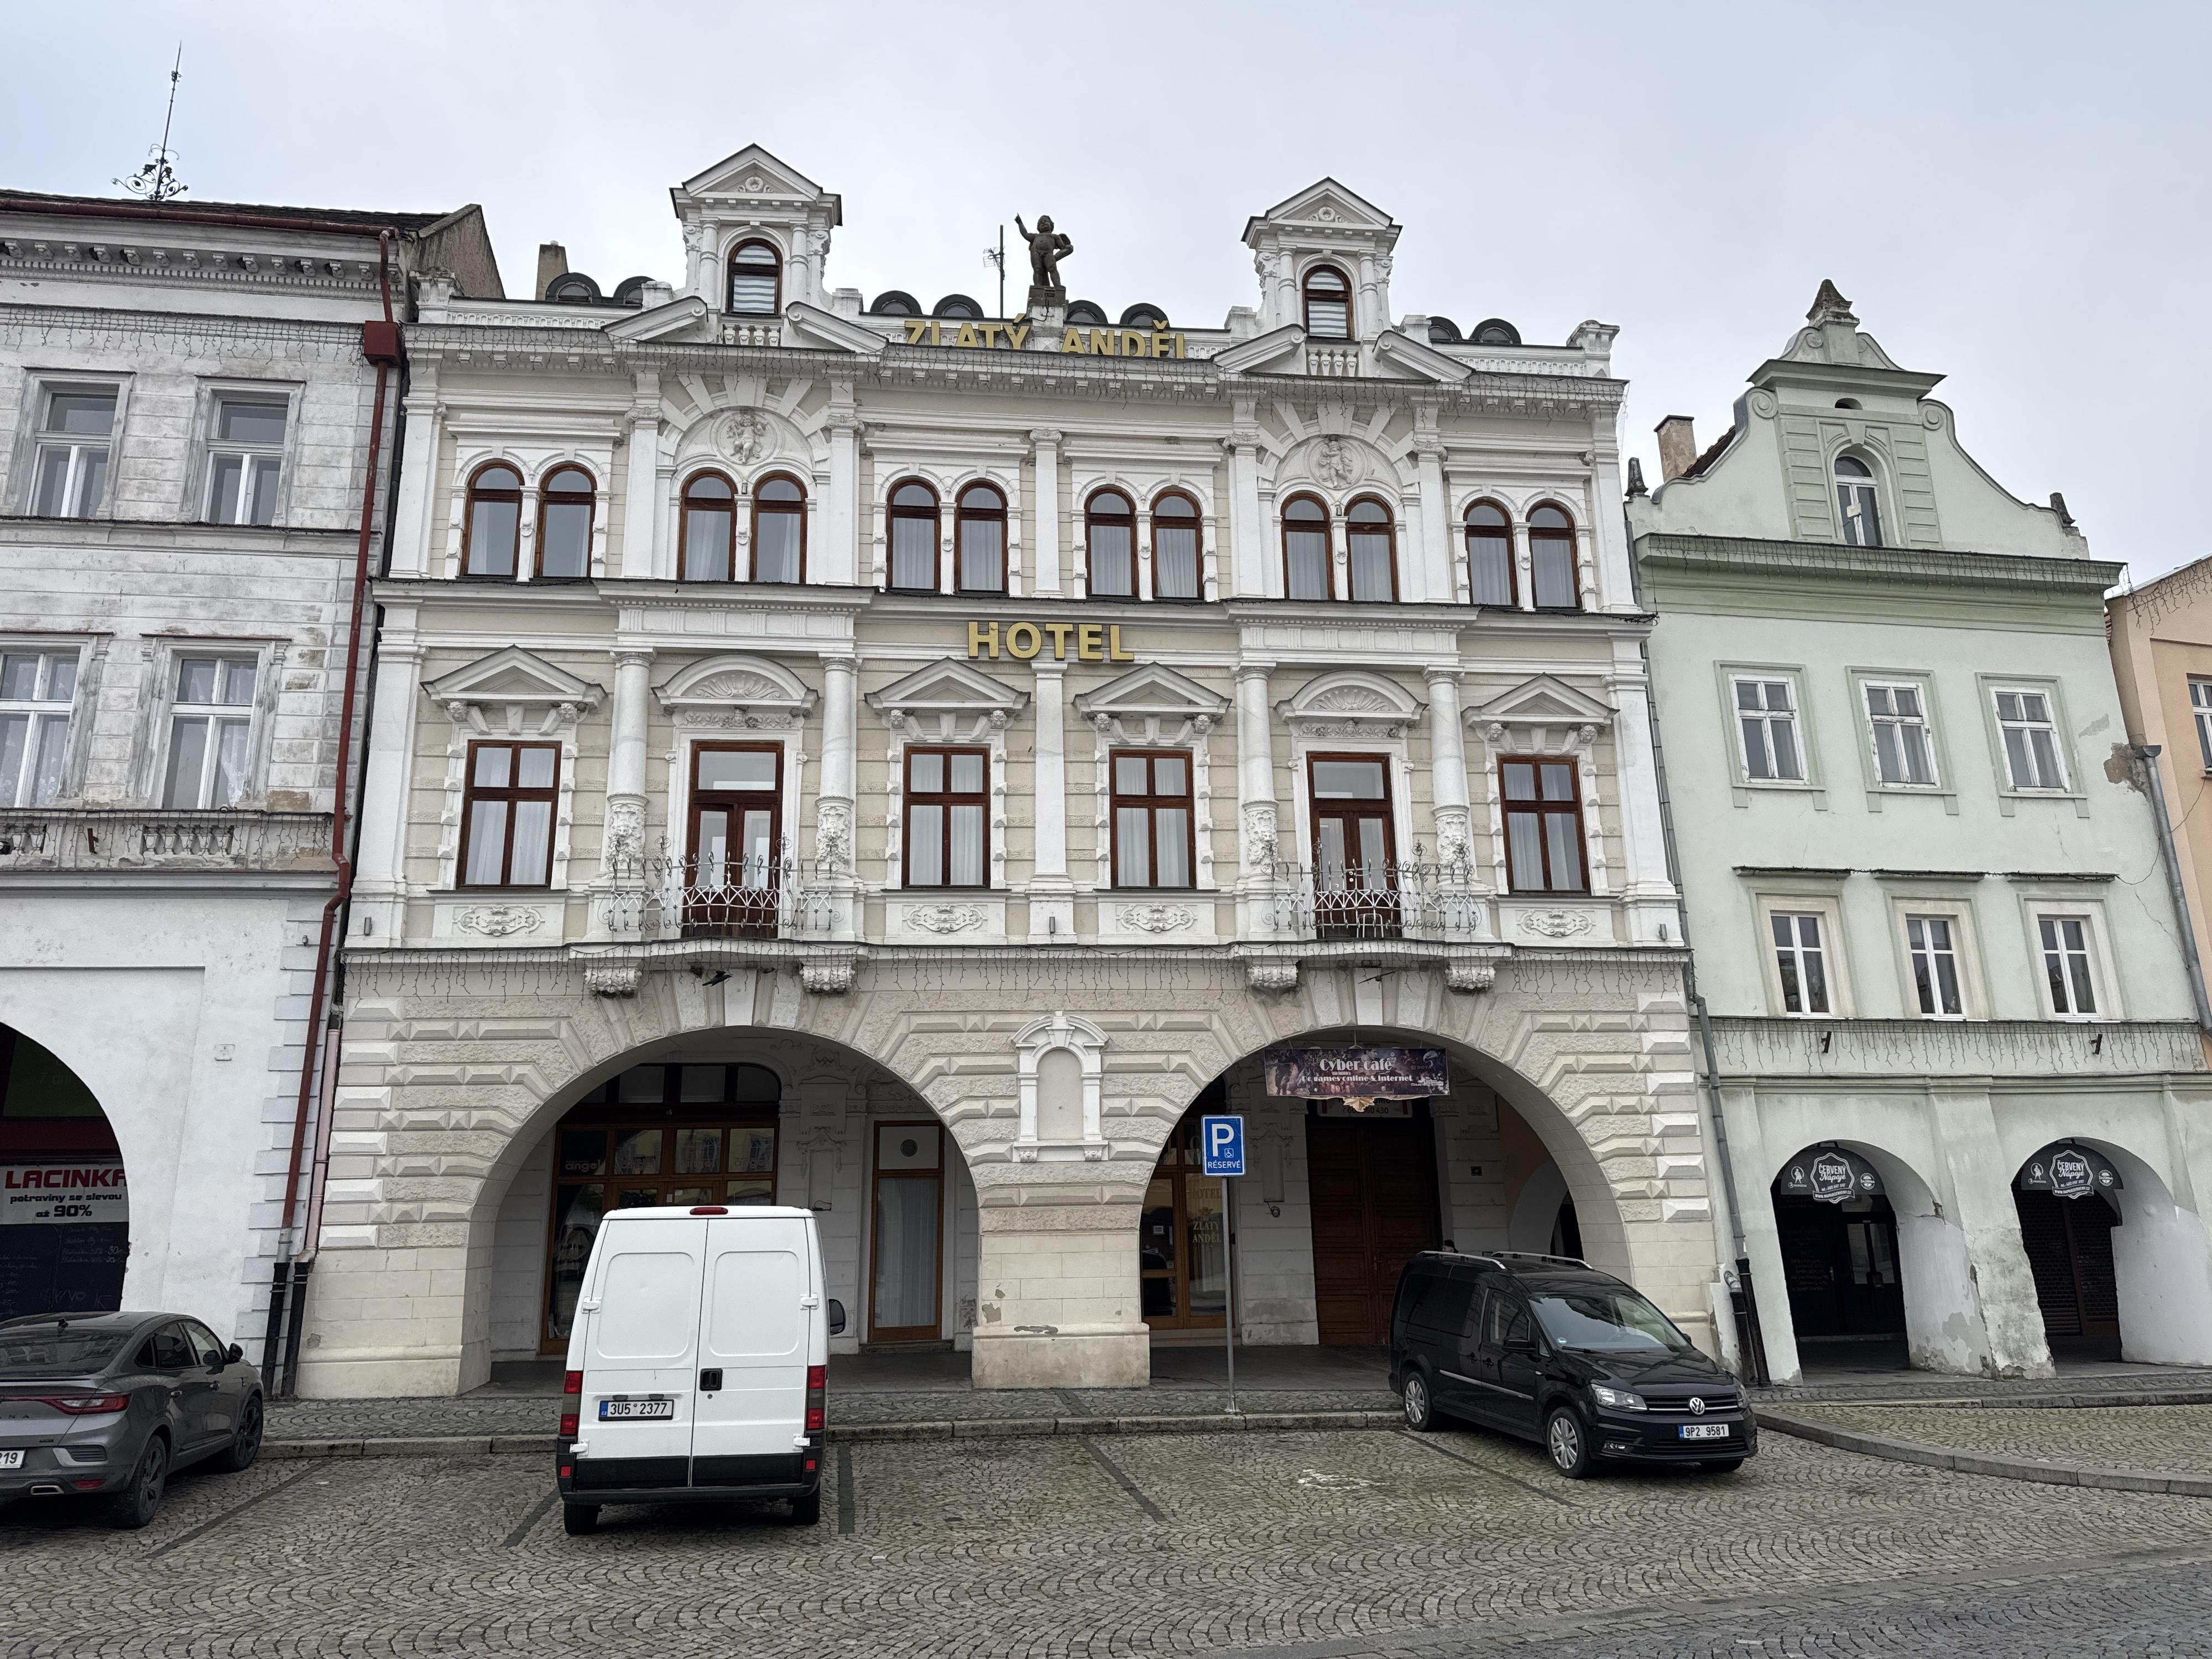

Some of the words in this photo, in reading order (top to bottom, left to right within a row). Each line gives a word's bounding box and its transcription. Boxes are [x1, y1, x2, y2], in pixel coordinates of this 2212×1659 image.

[968, 622, 1134, 662] HOTEL
[1320, 1058, 1360, 1071] Cyber
[1364, 1058, 1392, 1071] café
[1212, 1124, 1234, 1157] P
[1208, 1160, 1241, 1168] RÉSERVÉ
[1818, 1164, 1846, 1175] ČERVENÝ
[2057, 1160, 2084, 1171] ČERVENÝ
[5, 1169, 127, 1188] LACINKA
[1819, 1172, 1846, 1183] Nápoje
[2059, 1170, 2085, 1180] Nápoje
[10, 1193, 66, 1204] potraviny
[54, 1204, 92, 1217] 90%
[1193, 1219, 1221, 1230] ZLATÝ
[1192, 1232, 1222, 1243] ANDĚL
[610, 1403, 631, 1415] 3U5
[639, 1402, 667, 1415] 2377
[1686, 1427, 1700, 1437] 9P2
[1706, 1426, 1725, 1436] 9581
